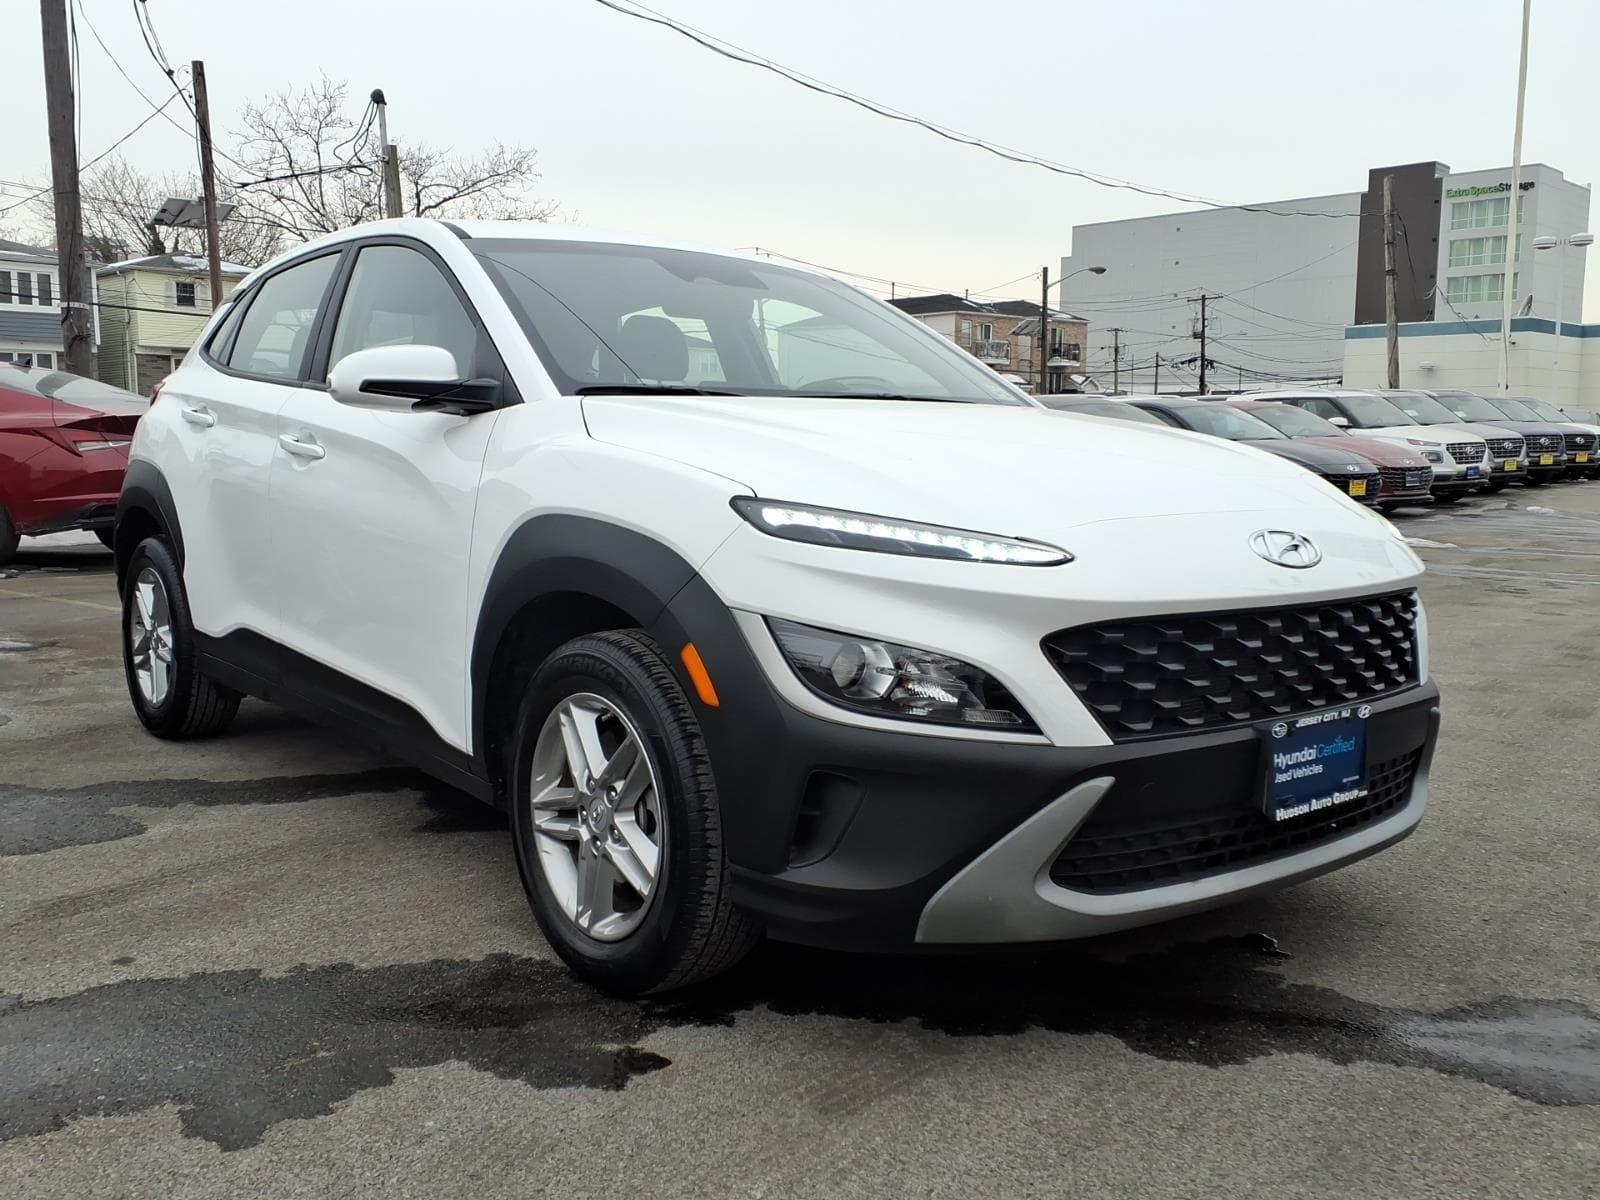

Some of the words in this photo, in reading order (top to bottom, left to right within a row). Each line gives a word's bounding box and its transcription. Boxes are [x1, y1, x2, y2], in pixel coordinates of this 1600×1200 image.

[1296, 715, 1322, 728] JERSEY
[1341, 709, 1351, 717] NJ
[1292, 764, 1323, 779] Vehicles
